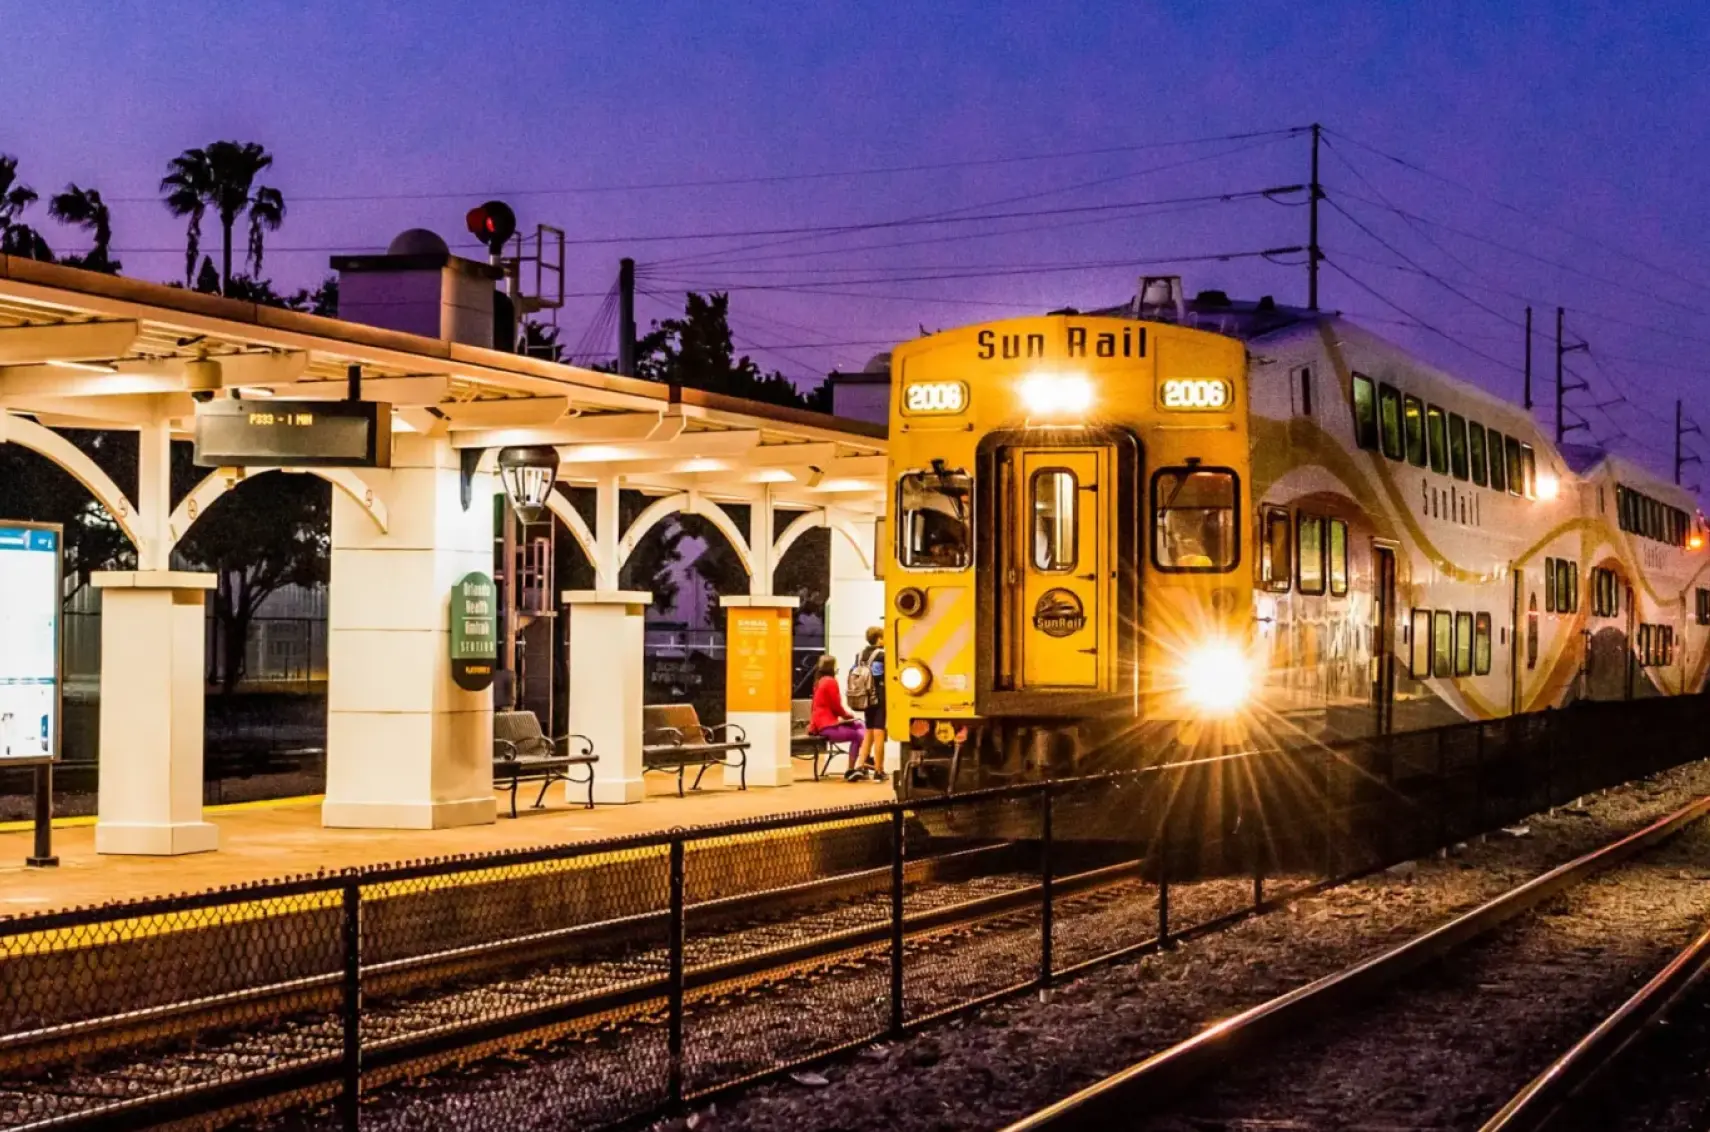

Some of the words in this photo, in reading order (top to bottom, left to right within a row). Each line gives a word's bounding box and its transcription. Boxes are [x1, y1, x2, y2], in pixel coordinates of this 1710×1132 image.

[978, 330, 1044, 360] Sun
[1067, 326, 1147, 358] Rail
[908, 383, 962, 410] 2006
[1165, 379, 1224, 407] 2006
[1421, 477, 1481, 527] SunRail
[1037, 617, 1082, 630] SunRail
